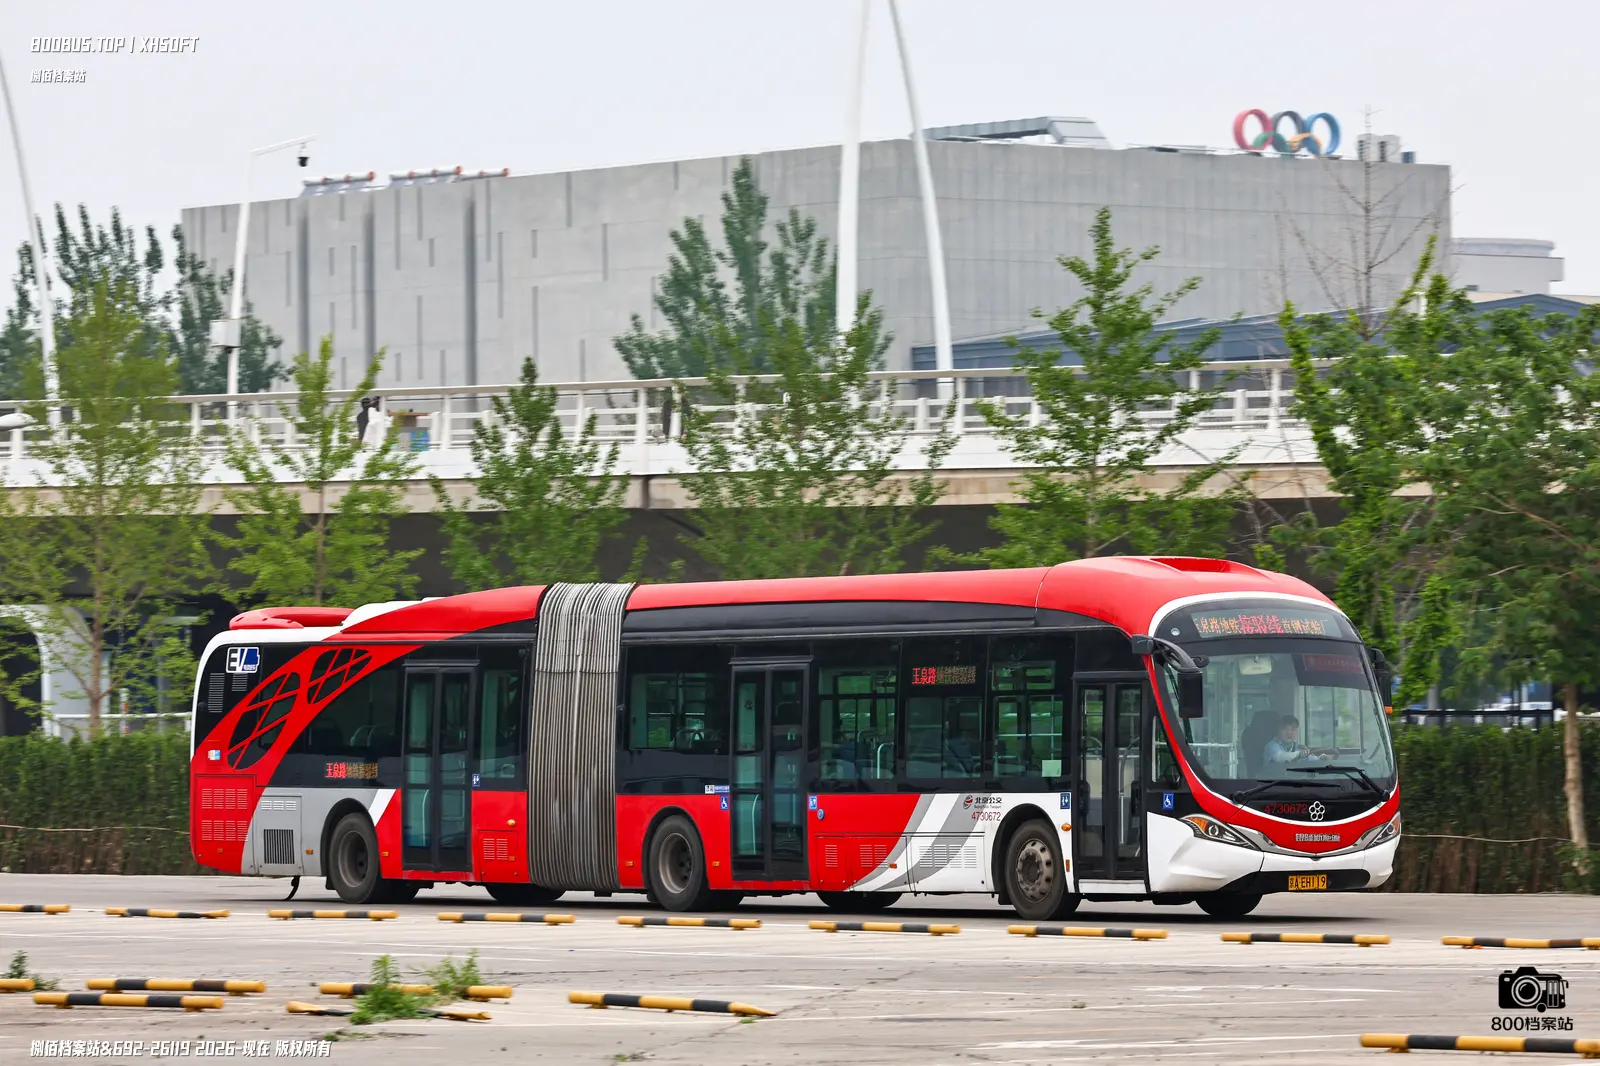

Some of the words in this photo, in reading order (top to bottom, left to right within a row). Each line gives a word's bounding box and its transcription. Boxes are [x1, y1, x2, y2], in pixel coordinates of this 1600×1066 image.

[975, 796, 1002, 804] 北京公交
[1264, 803, 1309, 814] 4730672
[971, 811, 1001, 822] 4730672
